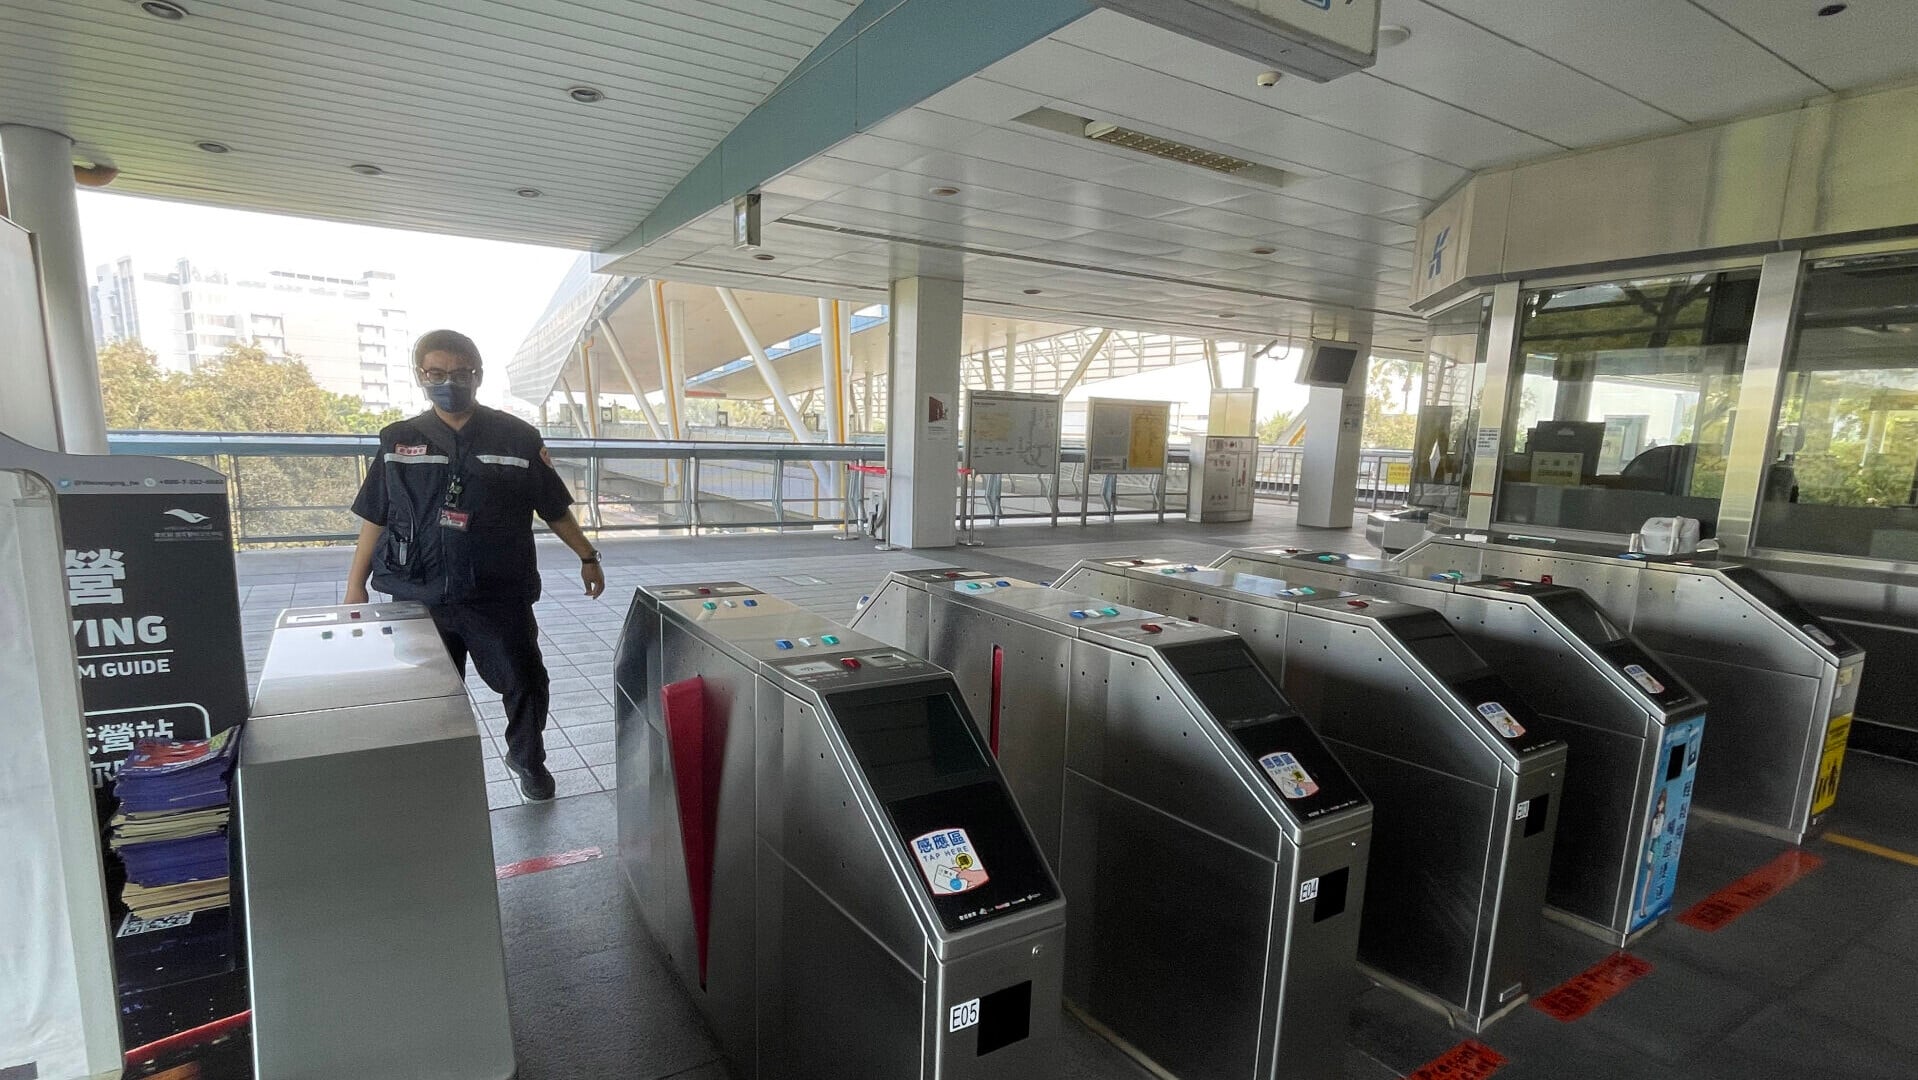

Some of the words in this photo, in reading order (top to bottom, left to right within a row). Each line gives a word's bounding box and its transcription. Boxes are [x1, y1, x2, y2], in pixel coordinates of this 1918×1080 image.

[65, 548, 126, 606] 營
[102, 659, 170, 677] GUIDE
[916, 830, 966, 853] 感應區
[923, 853, 941, 862] TAP
[945, 846, 969, 857] HERE
[1301, 880, 1317, 900] E04
[952, 1002, 977, 1029] E05
